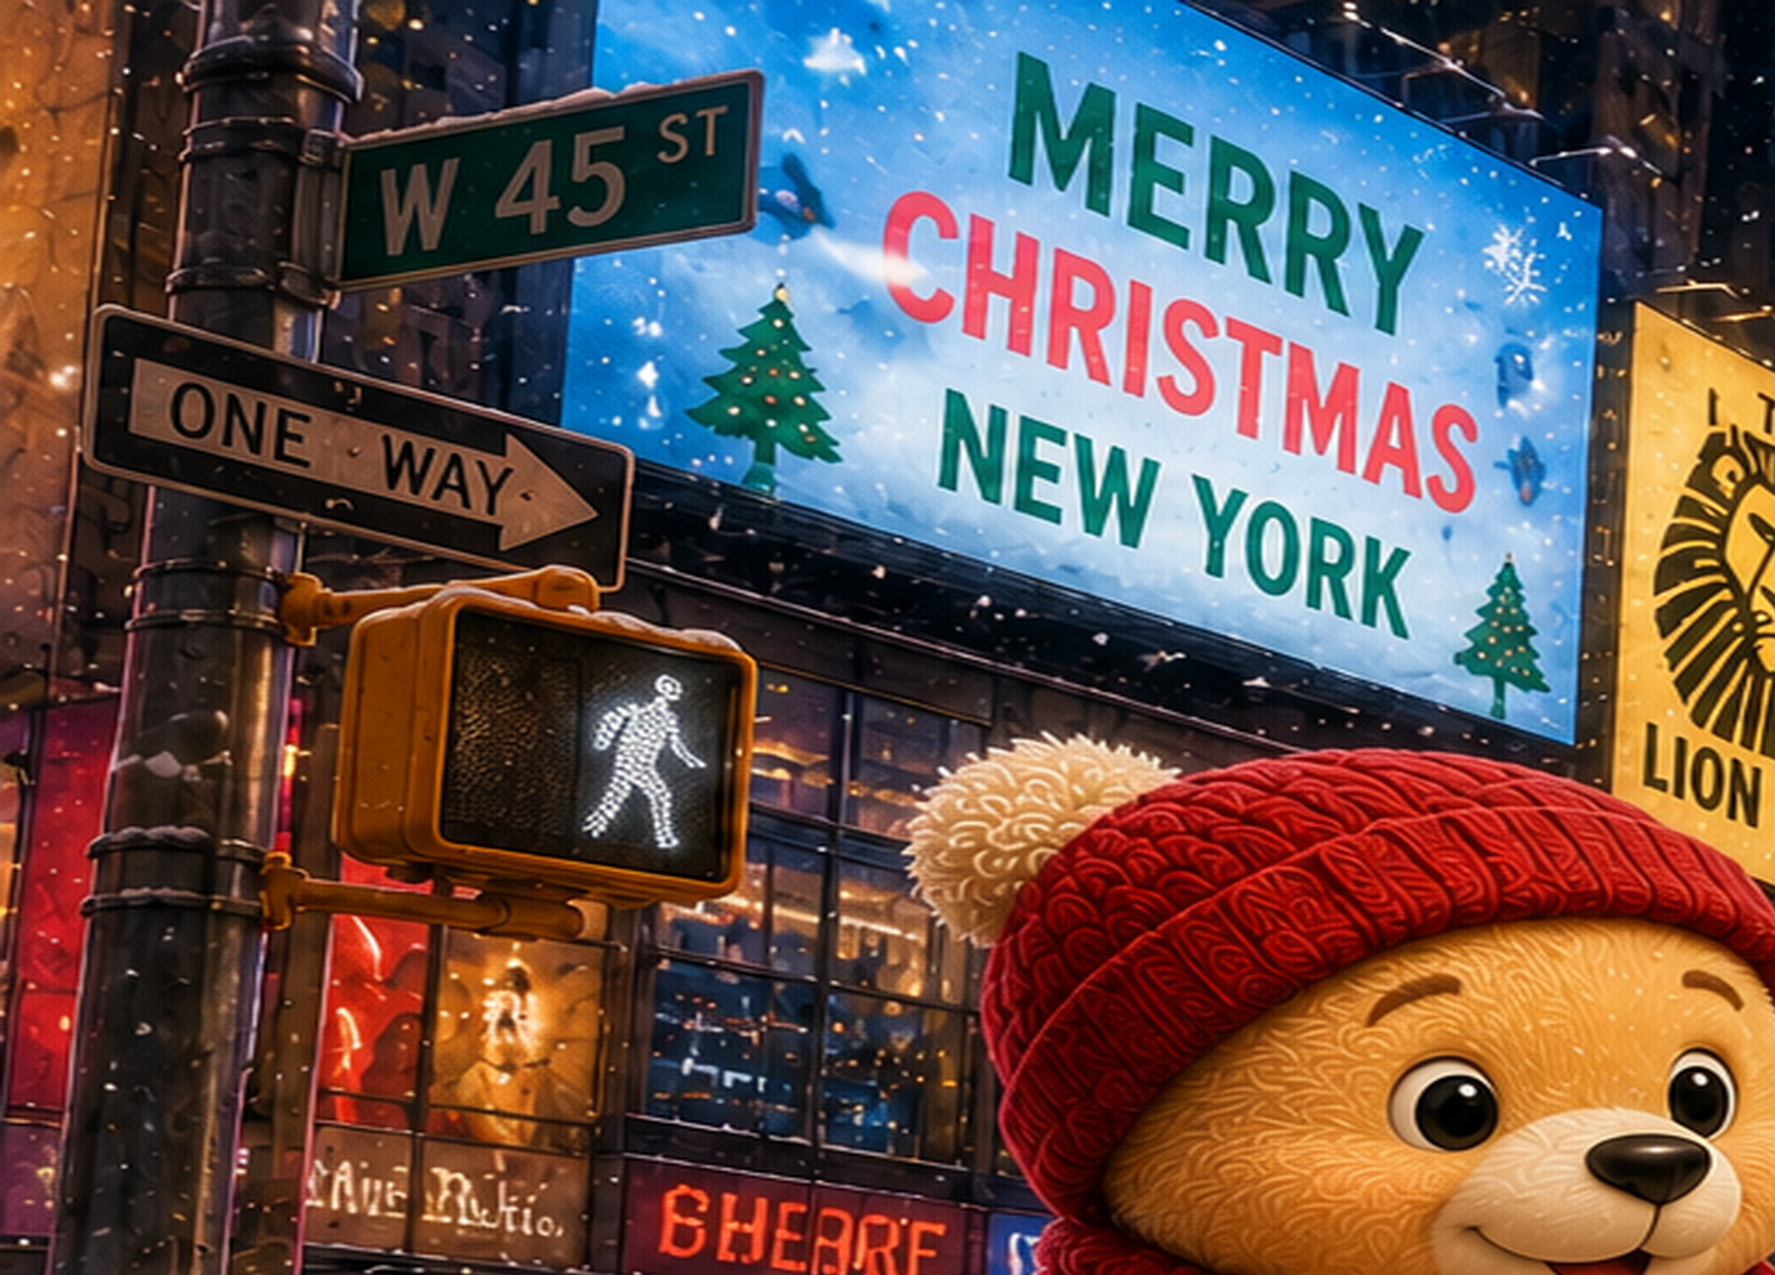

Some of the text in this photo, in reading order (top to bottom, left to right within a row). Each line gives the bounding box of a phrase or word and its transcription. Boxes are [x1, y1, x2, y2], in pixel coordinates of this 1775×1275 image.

[379, 104, 728, 256] W 45 ST
[1008, 51, 1425, 338] MERRY
[169, 382, 513, 517] ONE WAY
[882, 190, 1480, 515] CHRISTMAS
[937, 388, 1411, 641] NEW YORK
[1641, 722, 1760, 830] LION
